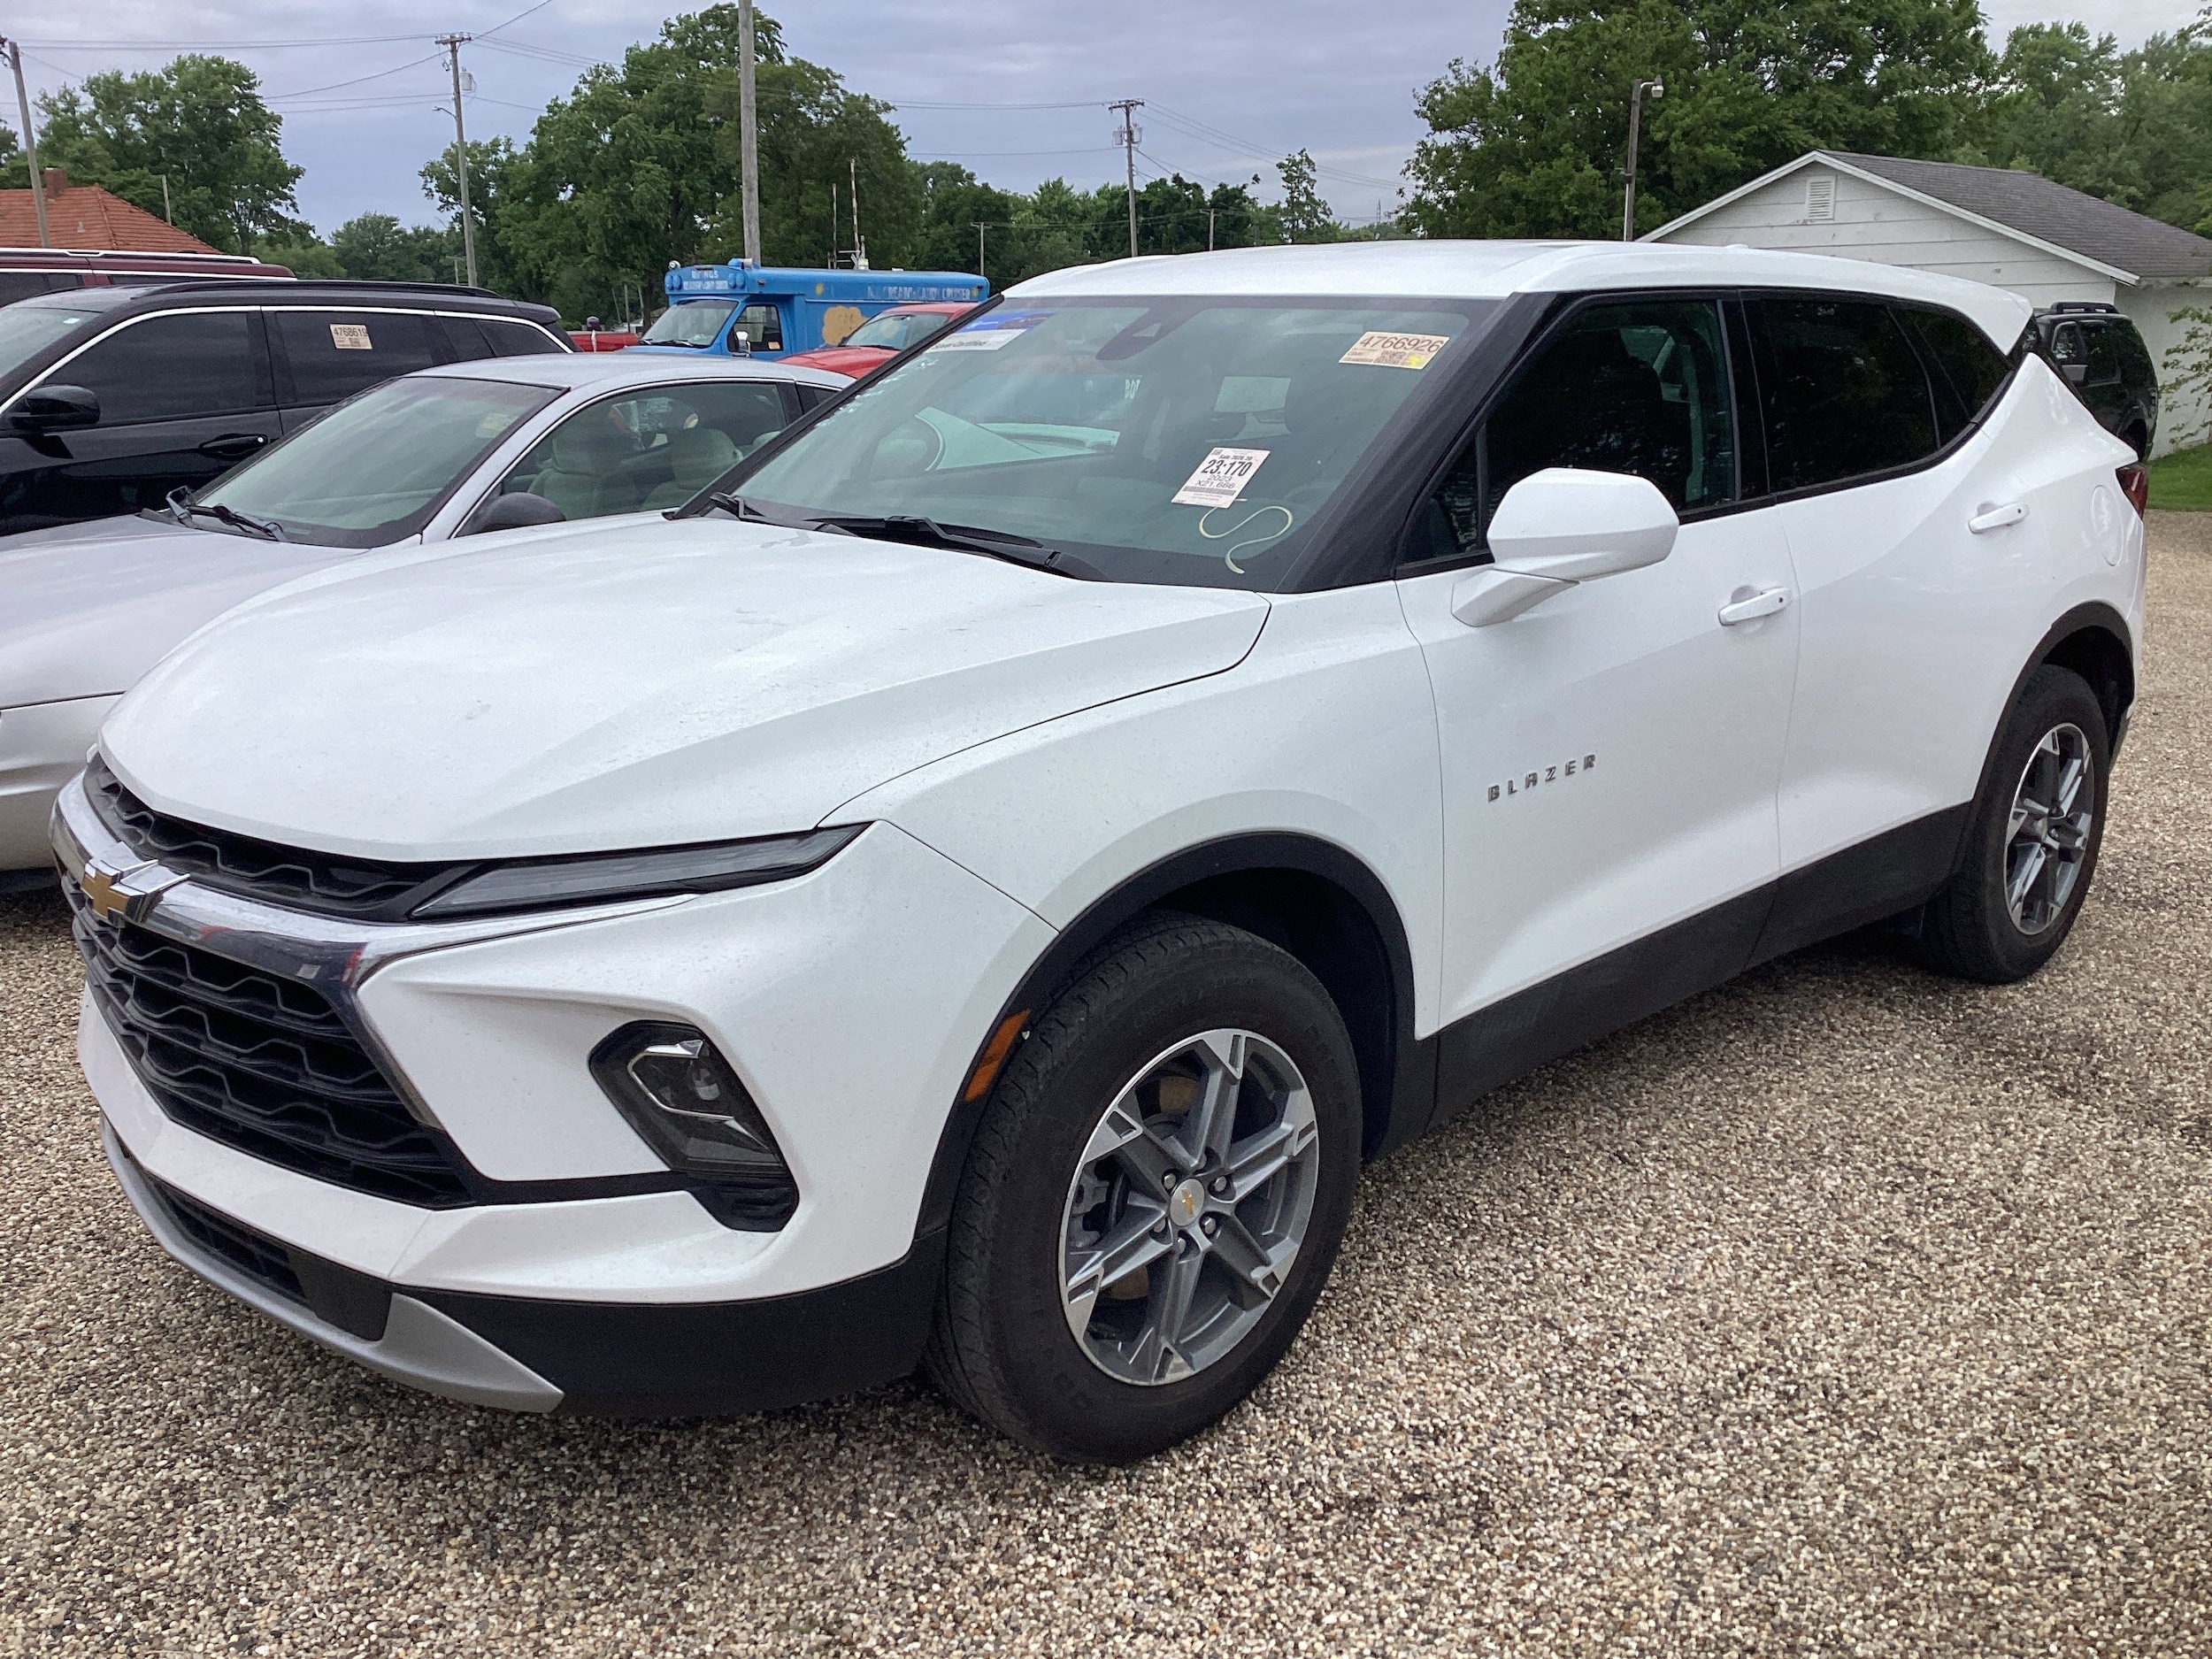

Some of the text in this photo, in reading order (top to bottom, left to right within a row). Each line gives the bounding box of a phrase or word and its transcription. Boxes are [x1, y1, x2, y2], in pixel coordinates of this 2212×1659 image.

[334, 327, 368, 337] 4768619
[1359, 335, 1445, 353] 4766926
[1201, 459, 1254, 477] 23:170
[1487, 754, 1596, 803] BLAZER
